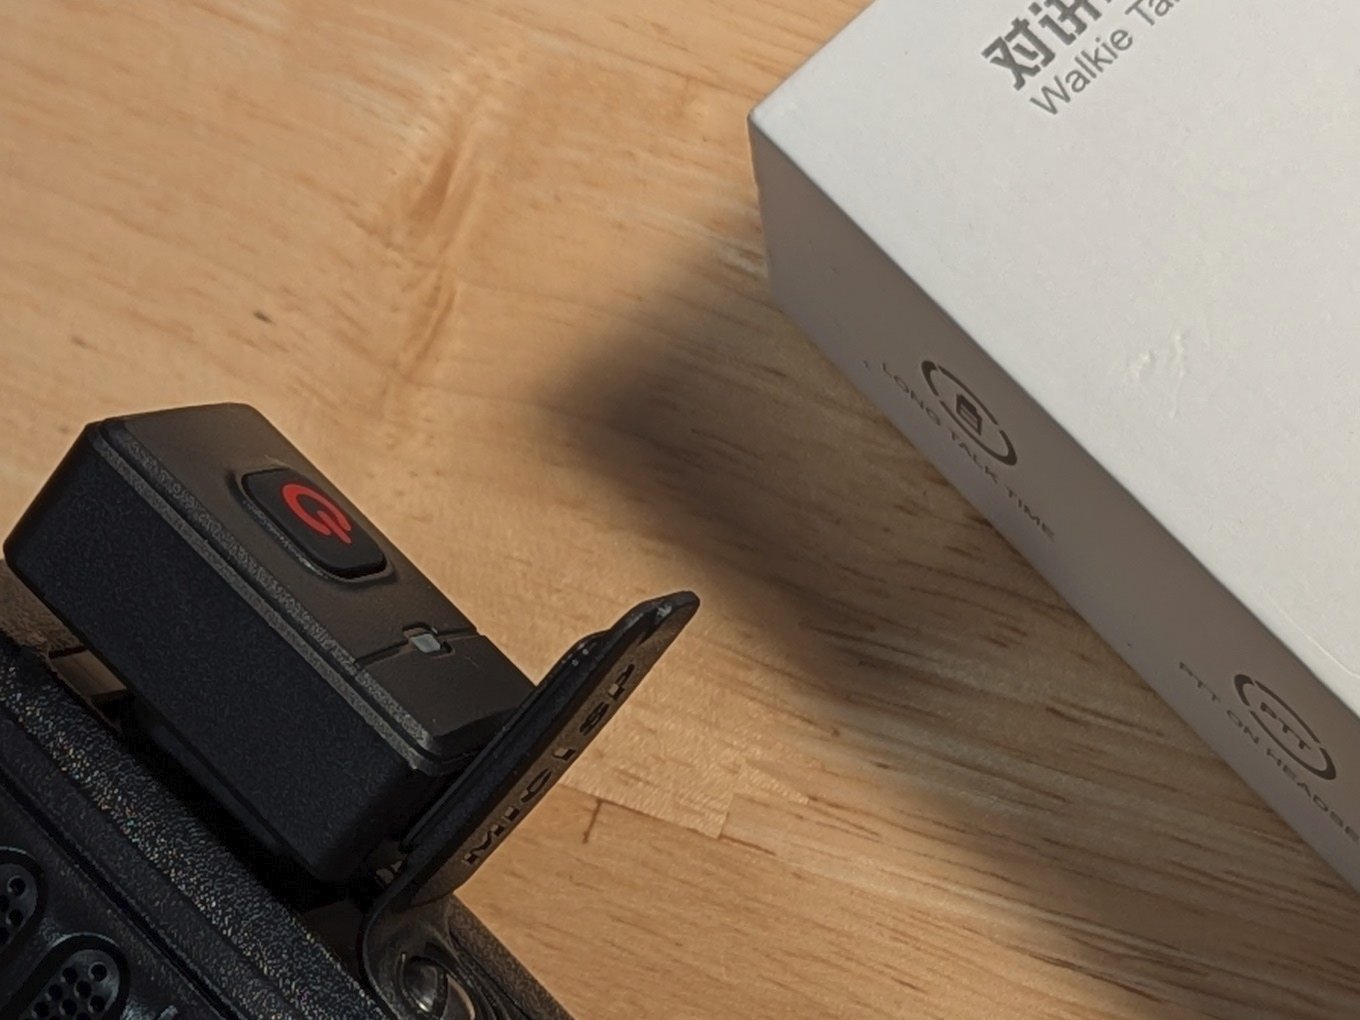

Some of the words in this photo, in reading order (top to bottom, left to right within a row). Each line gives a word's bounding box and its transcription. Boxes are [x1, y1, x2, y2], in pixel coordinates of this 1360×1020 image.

[1029, 29, 1133, 115] Walkie
[1124, 0, 1181, 26] Ta
[882, 362, 941, 427] LONG
[947, 425, 999, 485] TALK
[1006, 484, 1056, 540] TIME
[1179, 661, 1221, 703] PTT
[1226, 709, 1260, 745] ON
[1260, 702, 1311, 750] PTT
